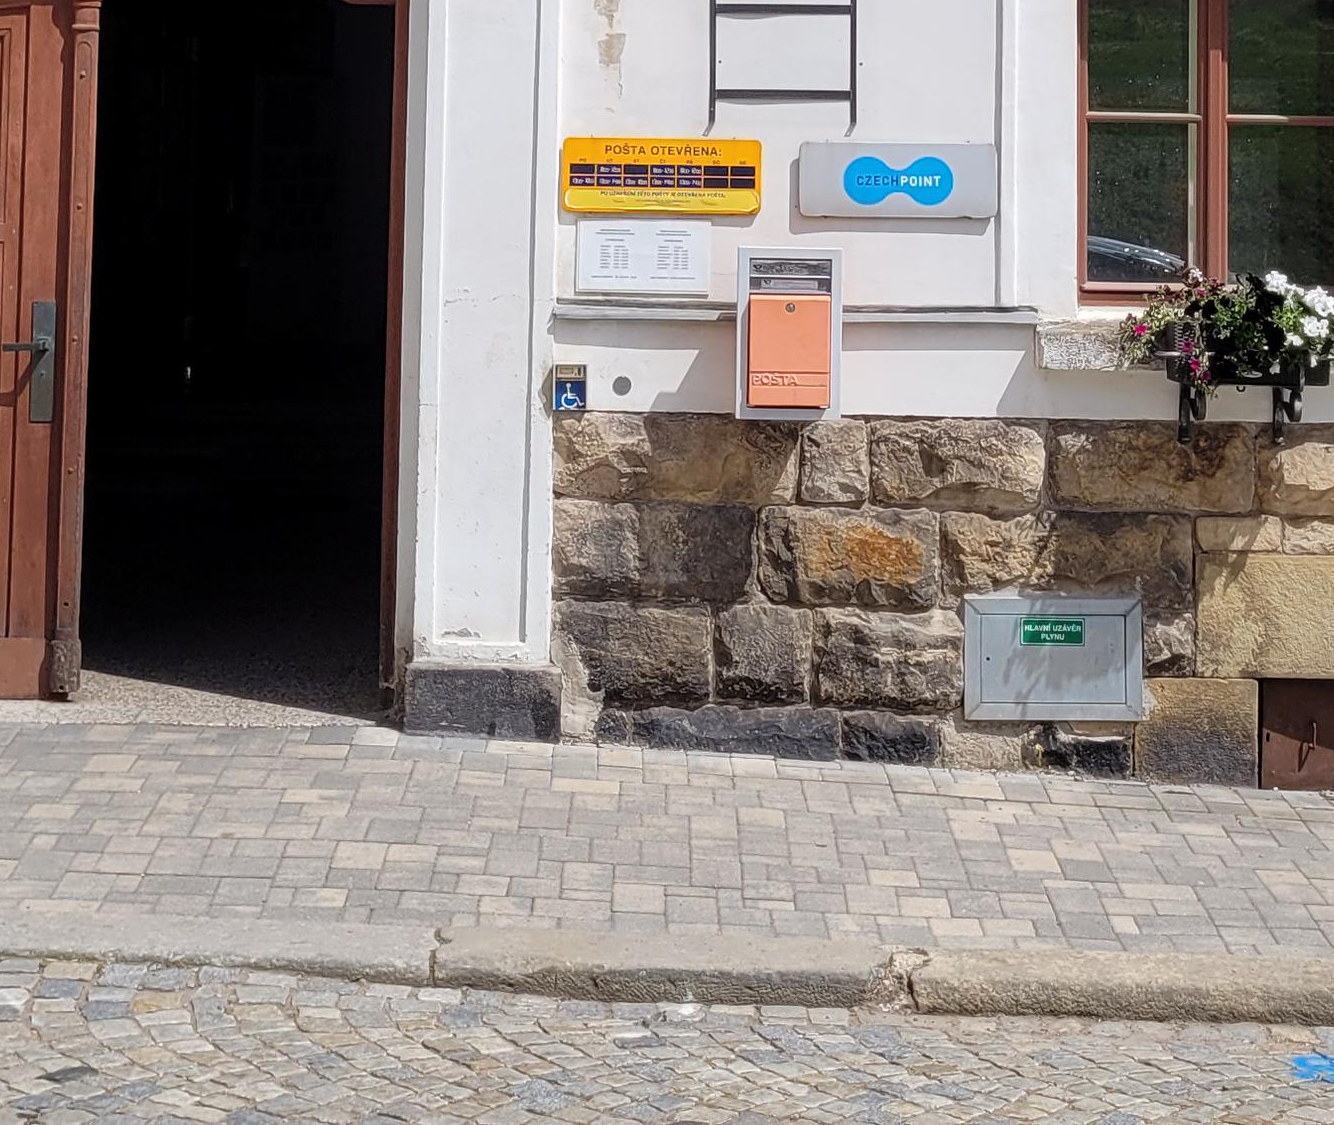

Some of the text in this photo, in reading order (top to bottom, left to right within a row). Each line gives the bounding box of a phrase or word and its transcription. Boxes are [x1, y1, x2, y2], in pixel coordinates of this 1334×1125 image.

[604, 143, 722, 156] POŠTA OTEVŘENA:
[751, 372, 800, 387] POŠTA
[1024, 623, 1082, 633] HLAVNÍ UZÁVĚR
[1040, 633, 1065, 641] PLYNU
